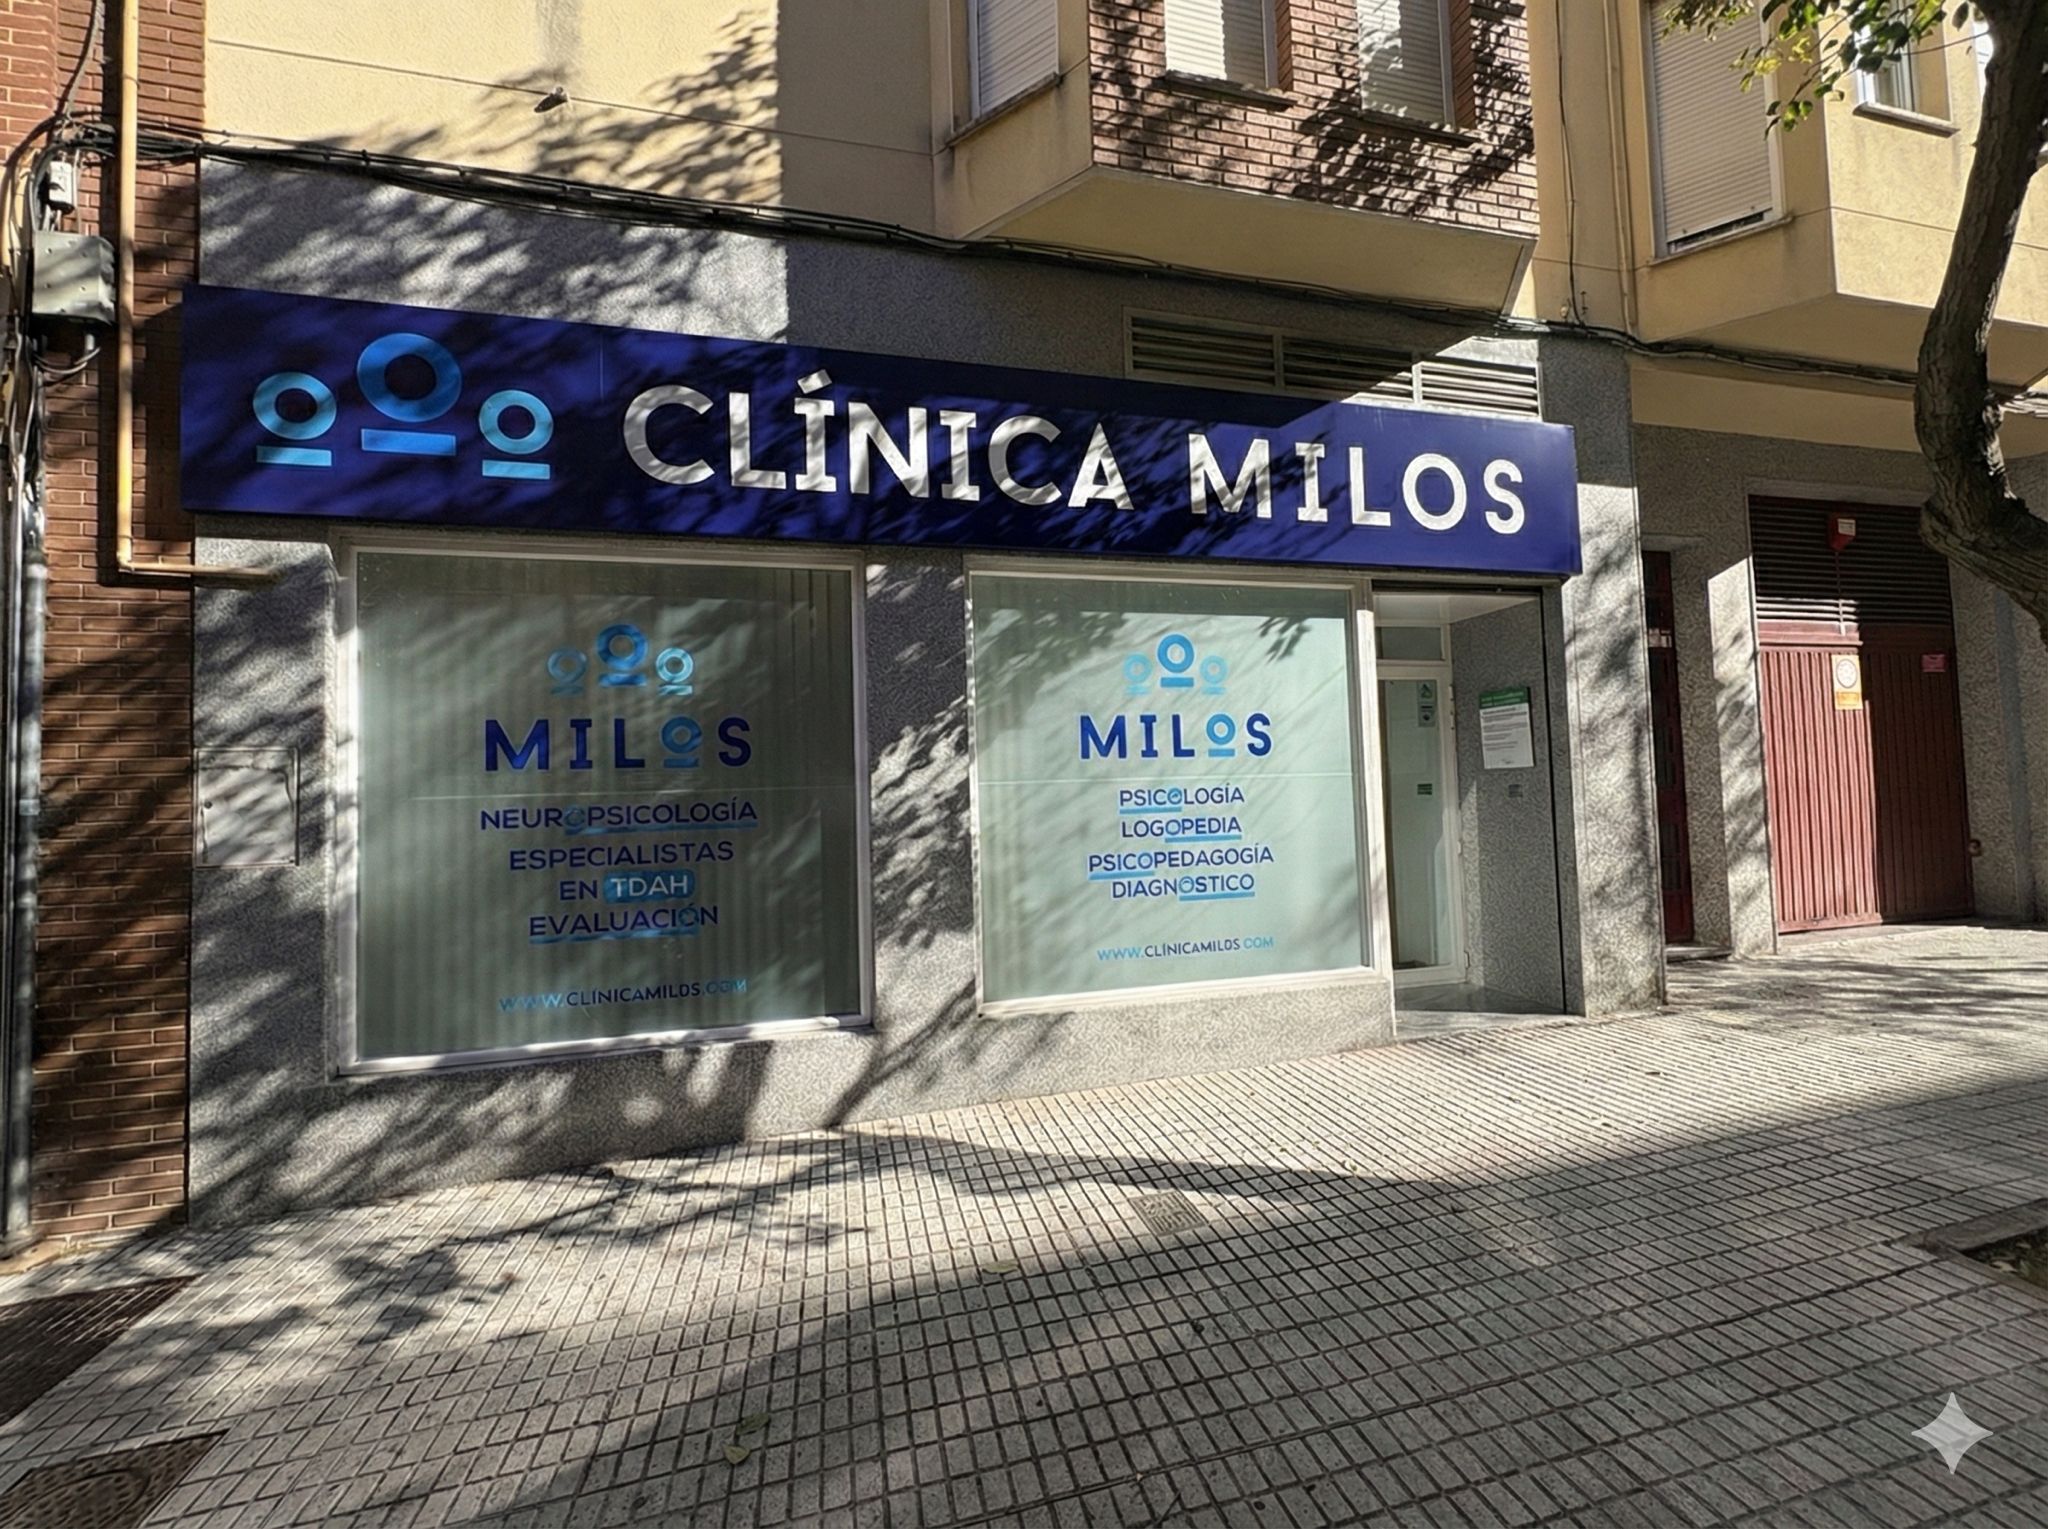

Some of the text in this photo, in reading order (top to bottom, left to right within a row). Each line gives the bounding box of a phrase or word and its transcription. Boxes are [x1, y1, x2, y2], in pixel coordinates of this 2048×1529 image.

[622, 368, 1526, 535] CLÍNICA MILOS
[485, 715, 752, 771] MILOS
[1080, 713, 1273, 760] MILOS
[1119, 783, 1245, 808] PSICOLOGÍA
[480, 797, 758, 831] NEUROPSICOLOGÍA
[1121, 817, 1242, 838] LOGOPEDIA
[509, 840, 734, 871] ESPECIALISTAS
[1088, 843, 1275, 872] PSICOPEDAGOGÍA
[559, 874, 689, 901] EN TDAH
[529, 903, 719, 936] EVALUACIÓN
